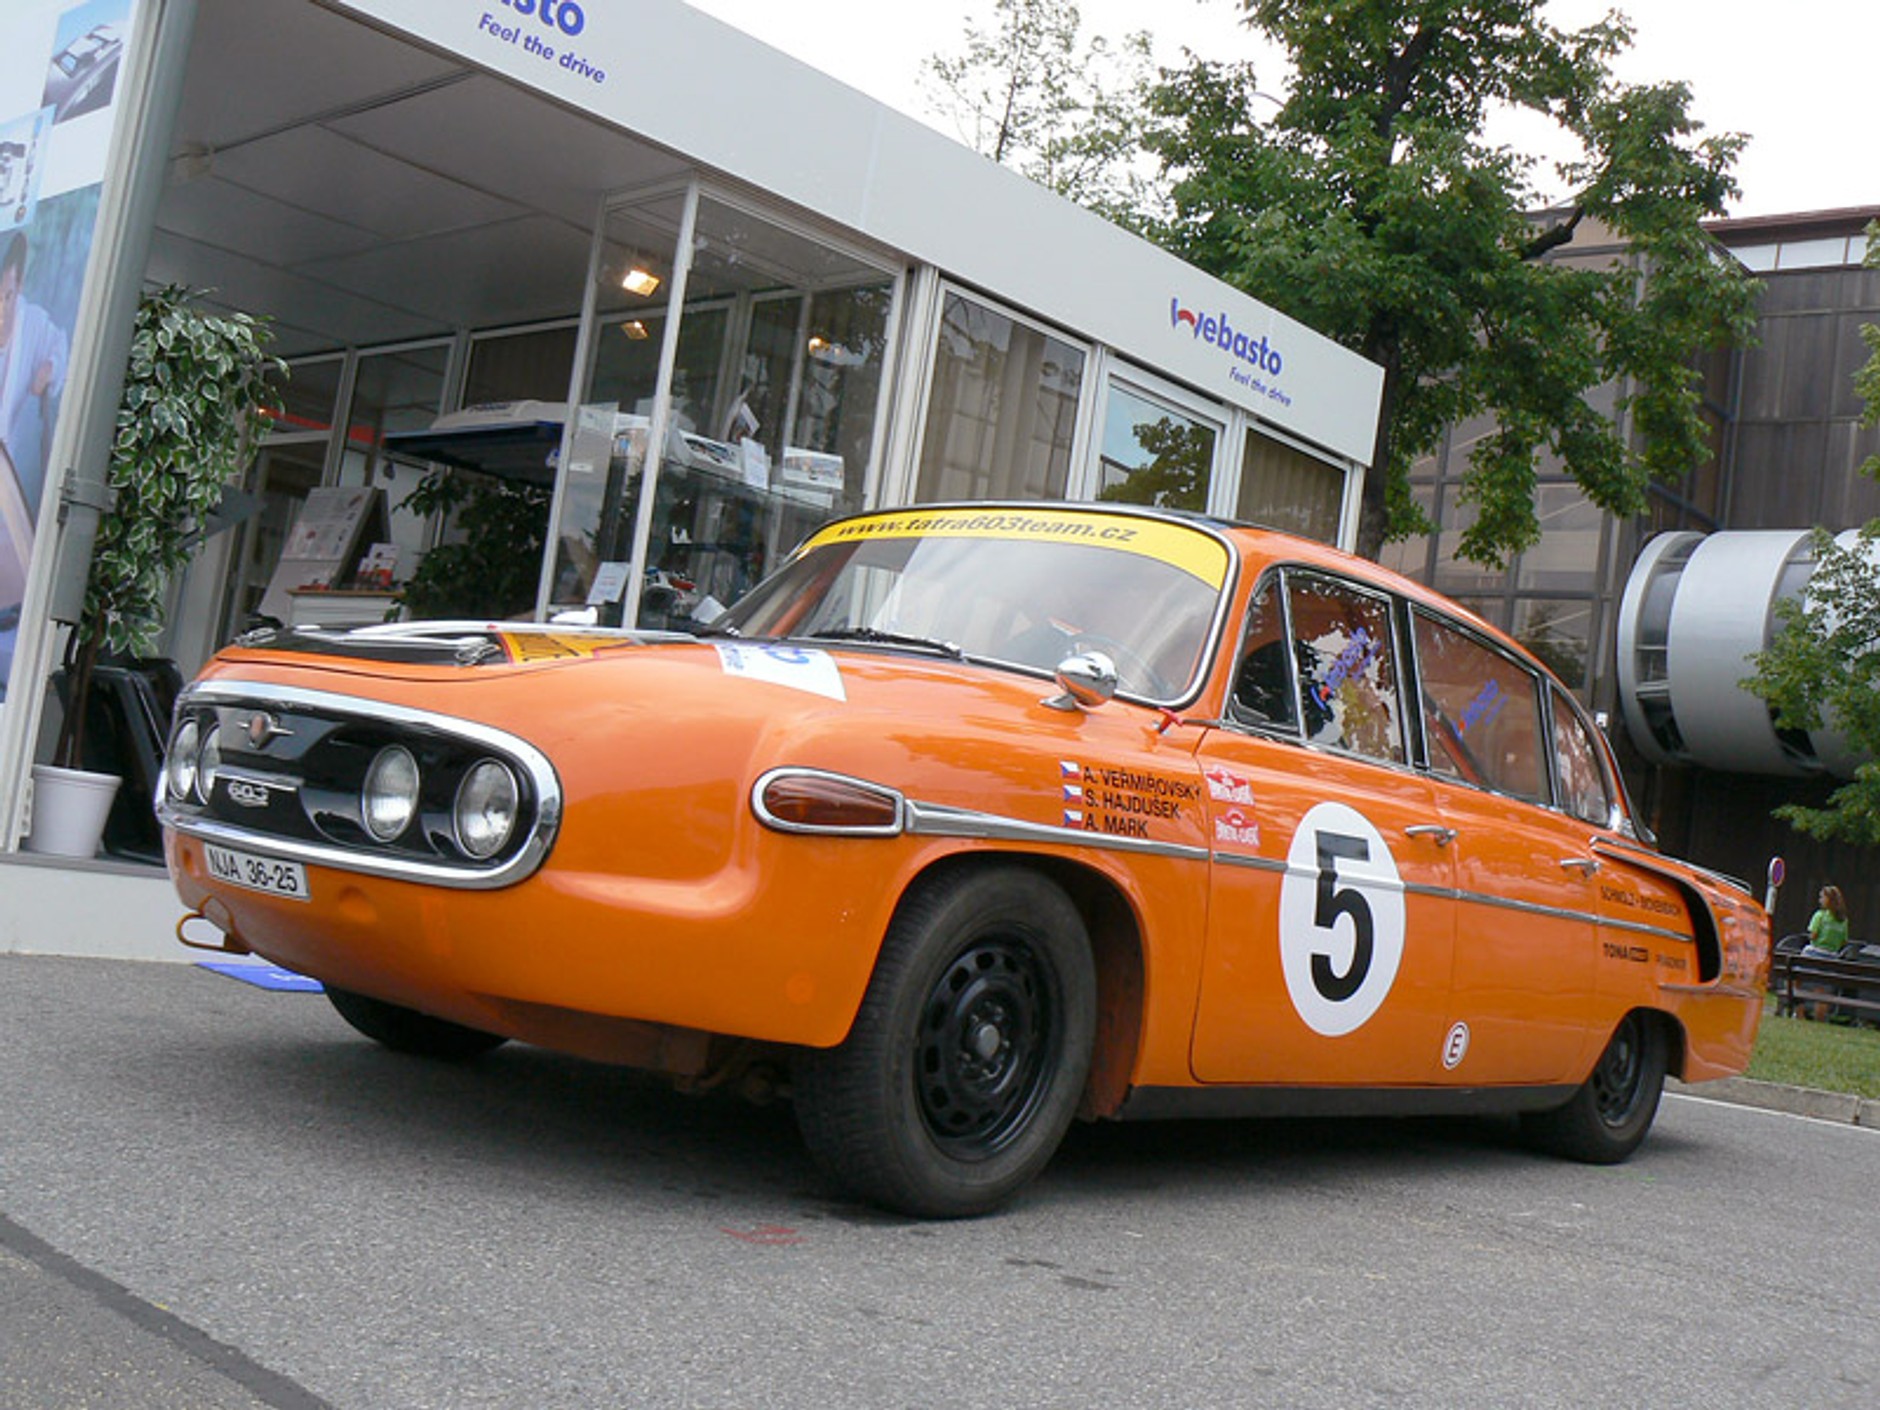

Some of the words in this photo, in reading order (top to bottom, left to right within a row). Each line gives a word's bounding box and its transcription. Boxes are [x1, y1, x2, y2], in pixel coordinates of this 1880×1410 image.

[479, 12, 521, 44] Feel
[523, 35, 555, 60] the
[559, 52, 606, 83] drive
[1171, 297, 1283, 377] Webasto
[1229, 366, 1251, 386] Feel
[1250, 378, 1268, 395] the
[837, 514, 1140, 543] www.tatra603team.cz
[1083, 766, 1099, 785] A.
[1084, 793, 1100, 808] S.
[1084, 813, 1099, 832] A.
[1104, 815, 1149, 838] MARK
[208, 848, 242, 881] NJA
[246, 859, 299, 893] 36-25
[1311, 829, 1374, 1003] 5
[1449, 1033, 1463, 1058] E
